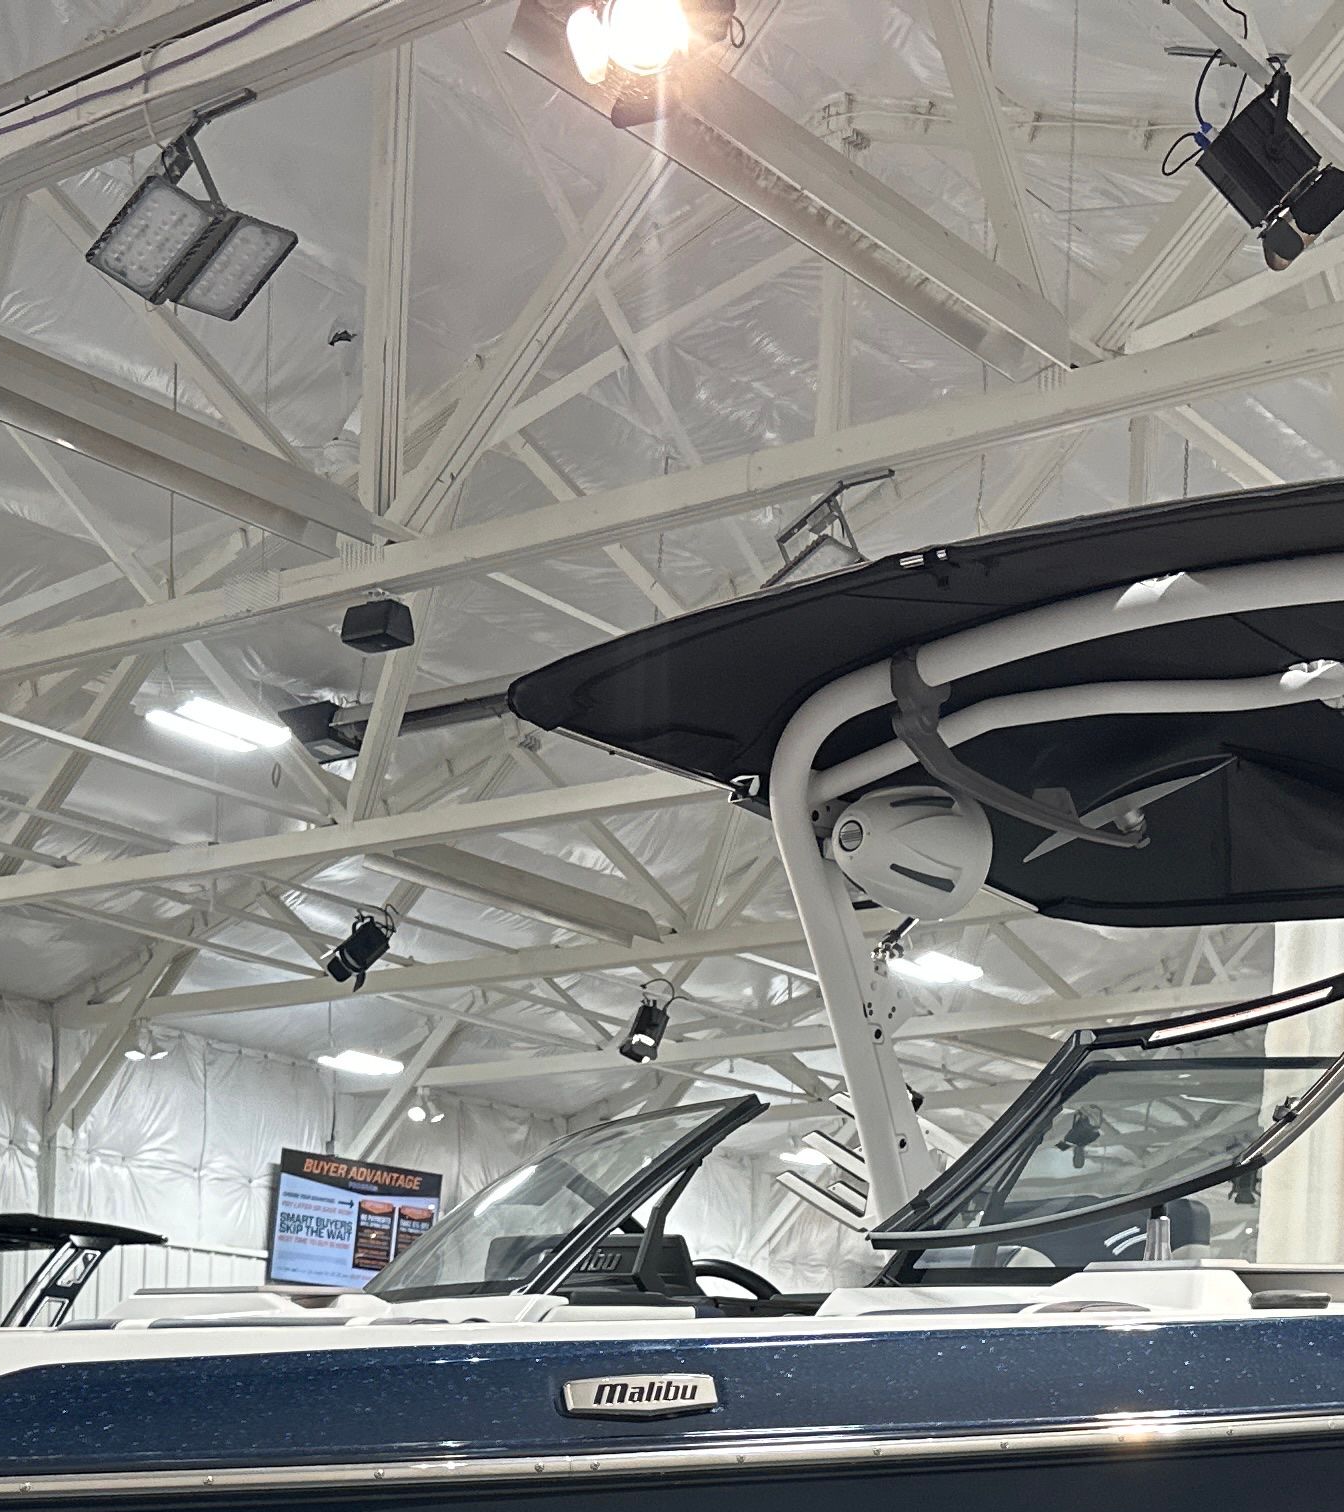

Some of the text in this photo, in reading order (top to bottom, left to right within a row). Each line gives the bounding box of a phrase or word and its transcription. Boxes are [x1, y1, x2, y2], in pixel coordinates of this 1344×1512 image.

[303, 1158, 348, 1178] BUYER
[348, 1166, 423, 1190] ADVANTAGE
[278, 1221, 352, 1242] SKIP THE WAIT
[280, 1212, 314, 1227] SMART
[316, 1216, 353, 1232] BUYERS
[593, 1380, 698, 1406] Malibu
